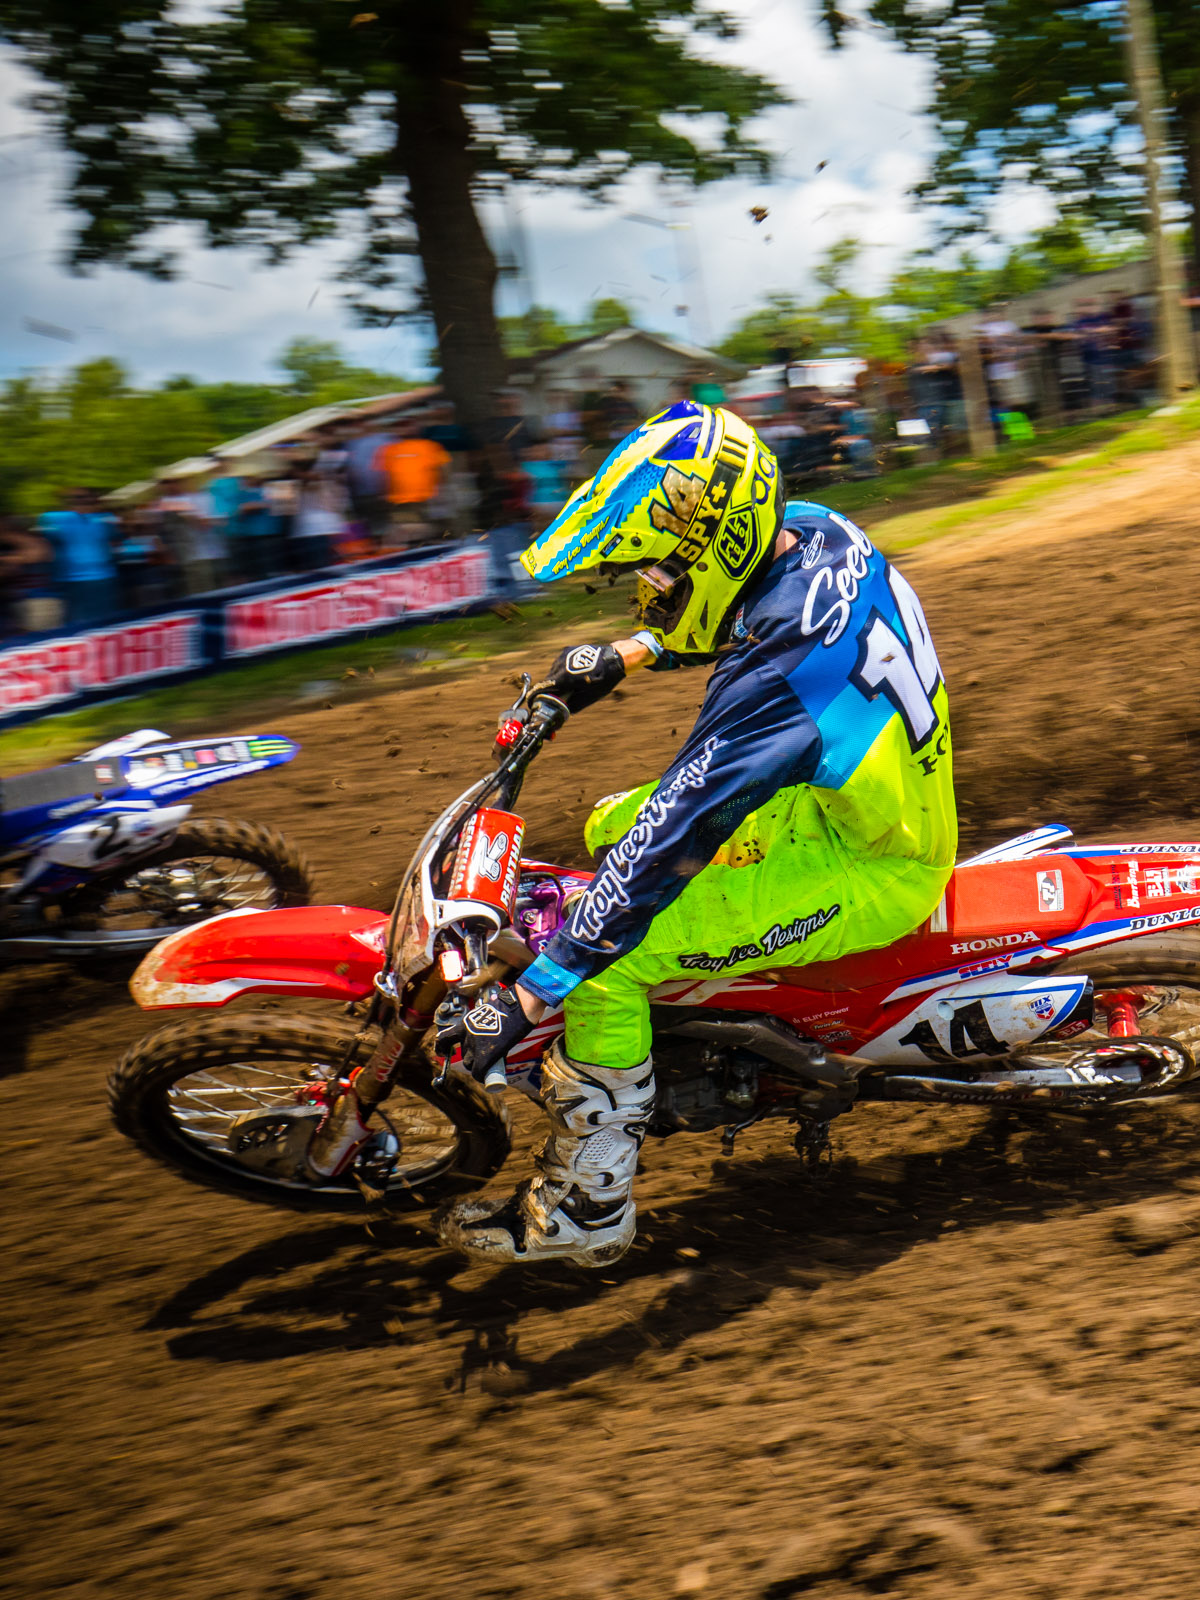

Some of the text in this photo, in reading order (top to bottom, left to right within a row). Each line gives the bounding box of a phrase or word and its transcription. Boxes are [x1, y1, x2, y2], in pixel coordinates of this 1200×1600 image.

[647, 462, 708, 540] 14
[800, 512, 873, 647] Seel
[847, 562, 946, 754] 14
[500, 824, 525, 907] RENTHAL
[571, 870, 632, 941] Troy
[678, 903, 842, 972] Troy Lee Designs
[950, 930, 1041, 955] HONDA
[957, 954, 1014, 980] SEELY
[824, 1006, 849, 1017] Power
[898, 999, 1013, 1064] 14
